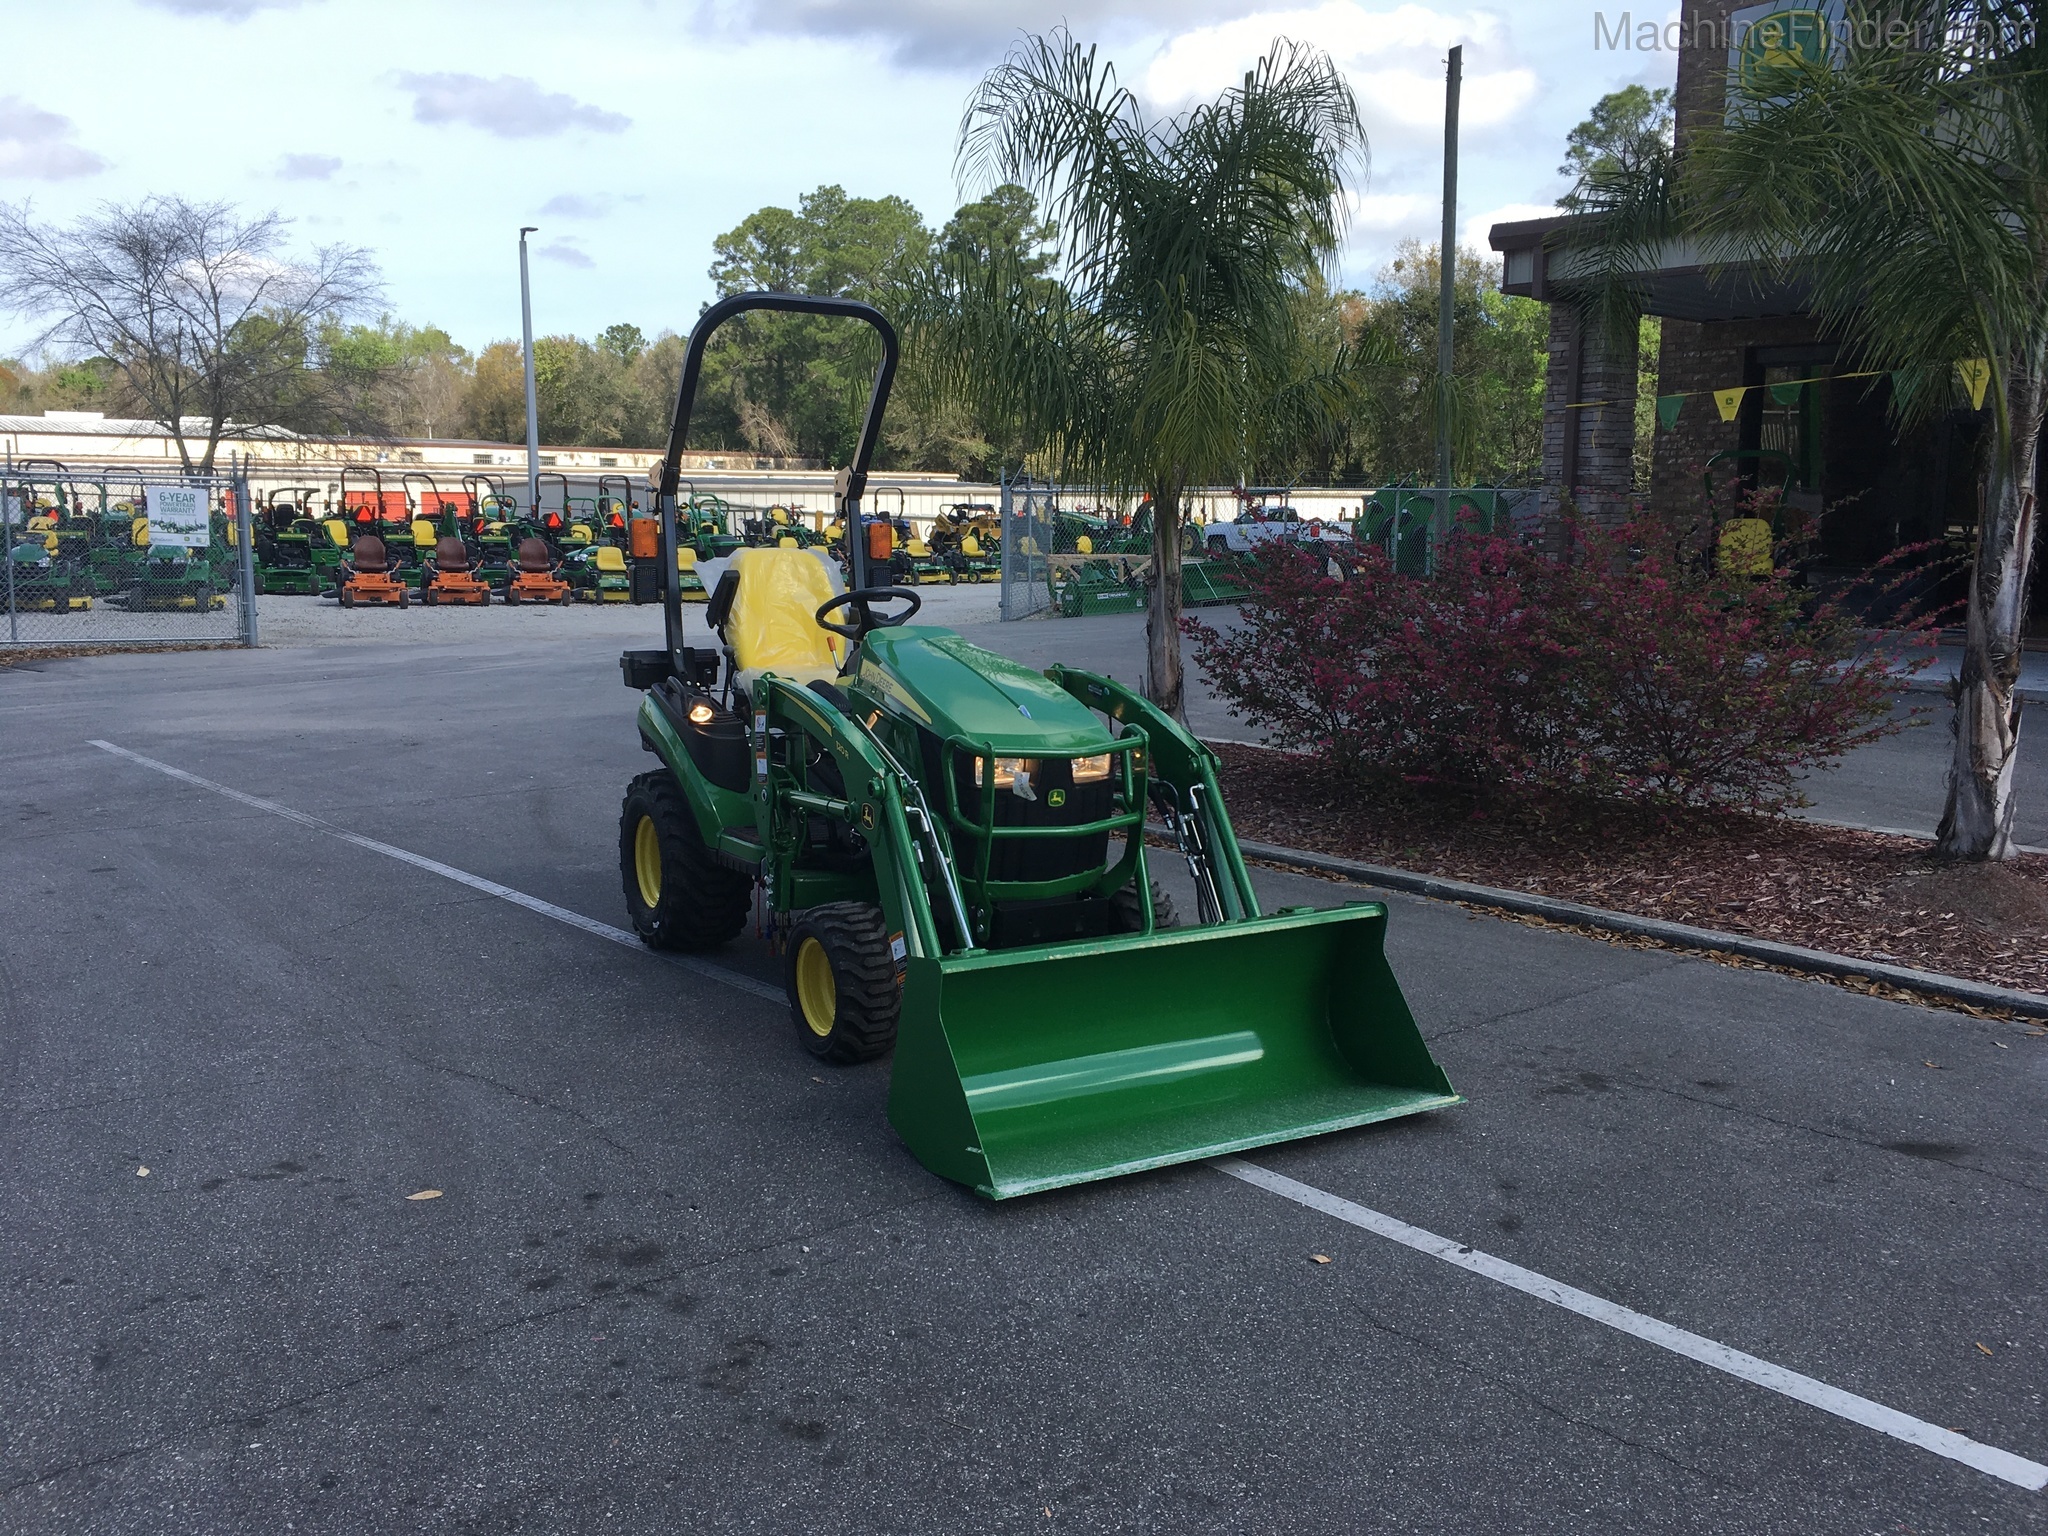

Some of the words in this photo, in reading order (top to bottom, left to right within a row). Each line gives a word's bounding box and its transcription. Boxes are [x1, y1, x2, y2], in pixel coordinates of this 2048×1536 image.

[159, 492, 196, 503] 6-YEAR
[861, 666, 877, 684] JOHN
[875, 671, 894, 693] DEERE
